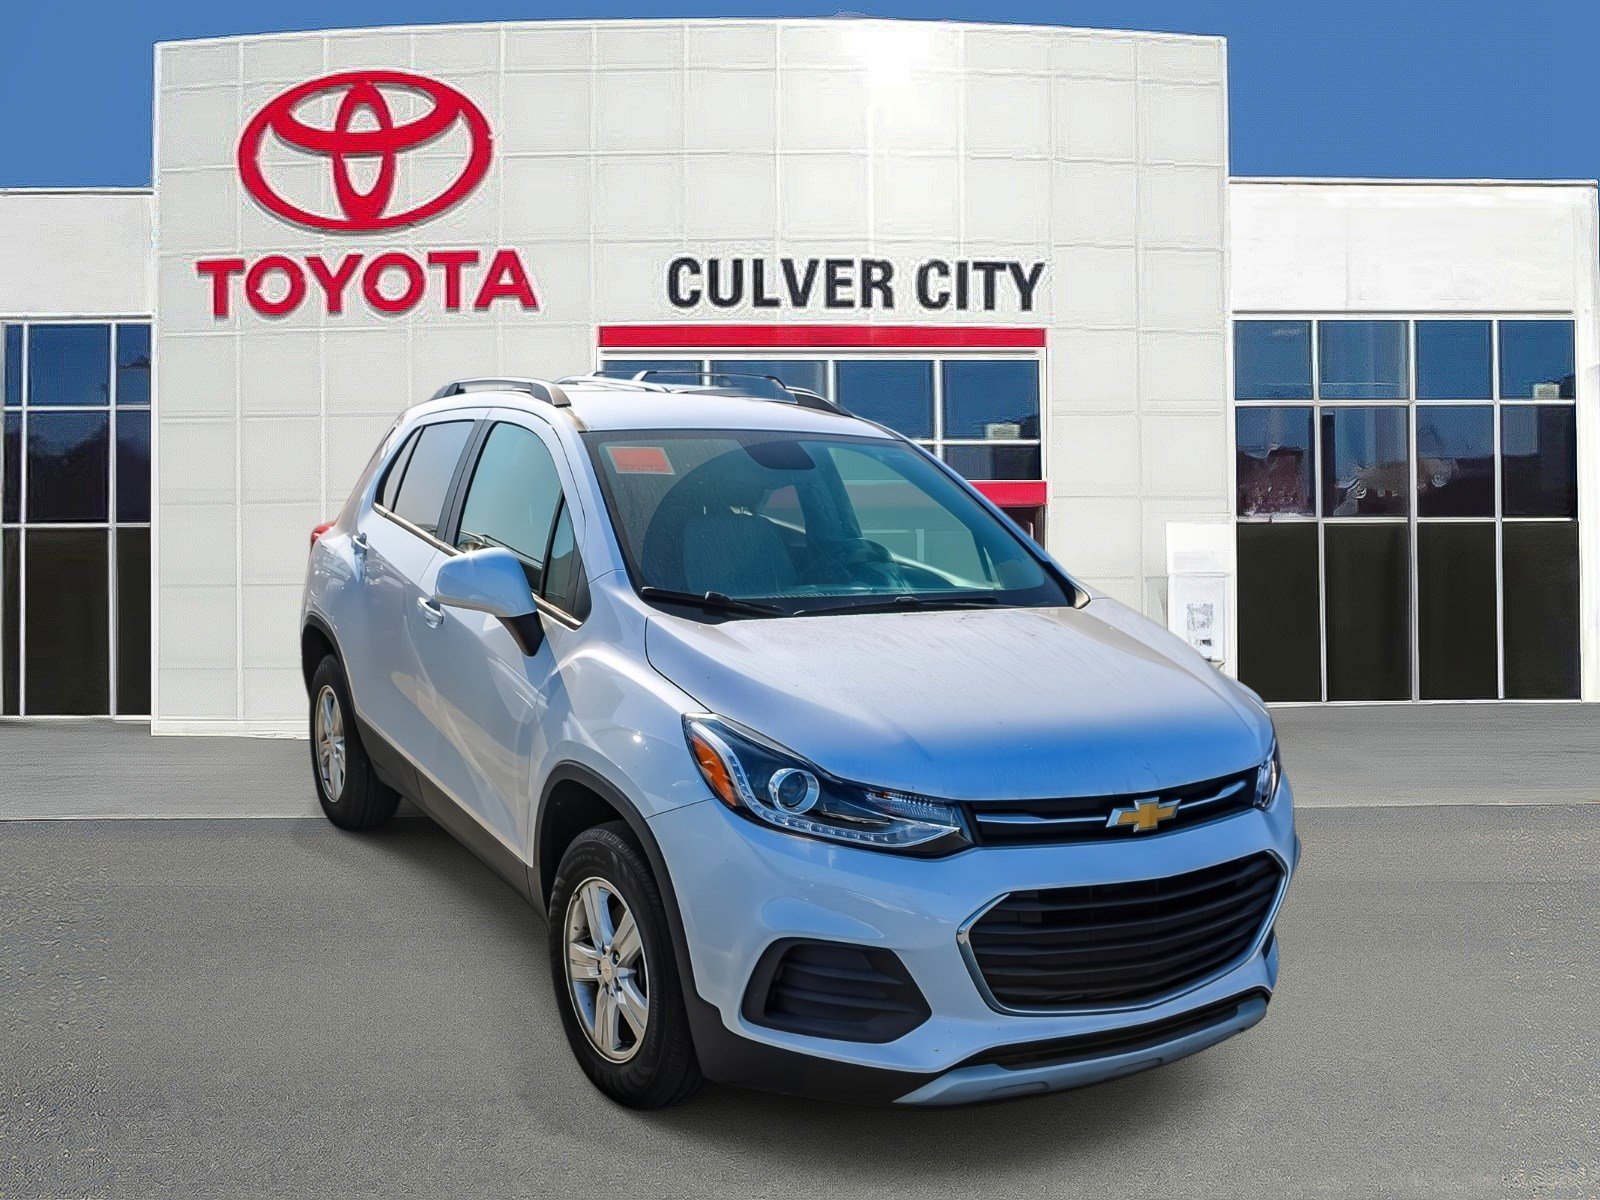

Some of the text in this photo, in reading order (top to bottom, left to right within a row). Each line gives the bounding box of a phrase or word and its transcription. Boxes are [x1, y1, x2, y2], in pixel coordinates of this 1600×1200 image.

[195, 250, 539, 317] TOYOTA
[667, 258, 1045, 310] CULVER CITY
